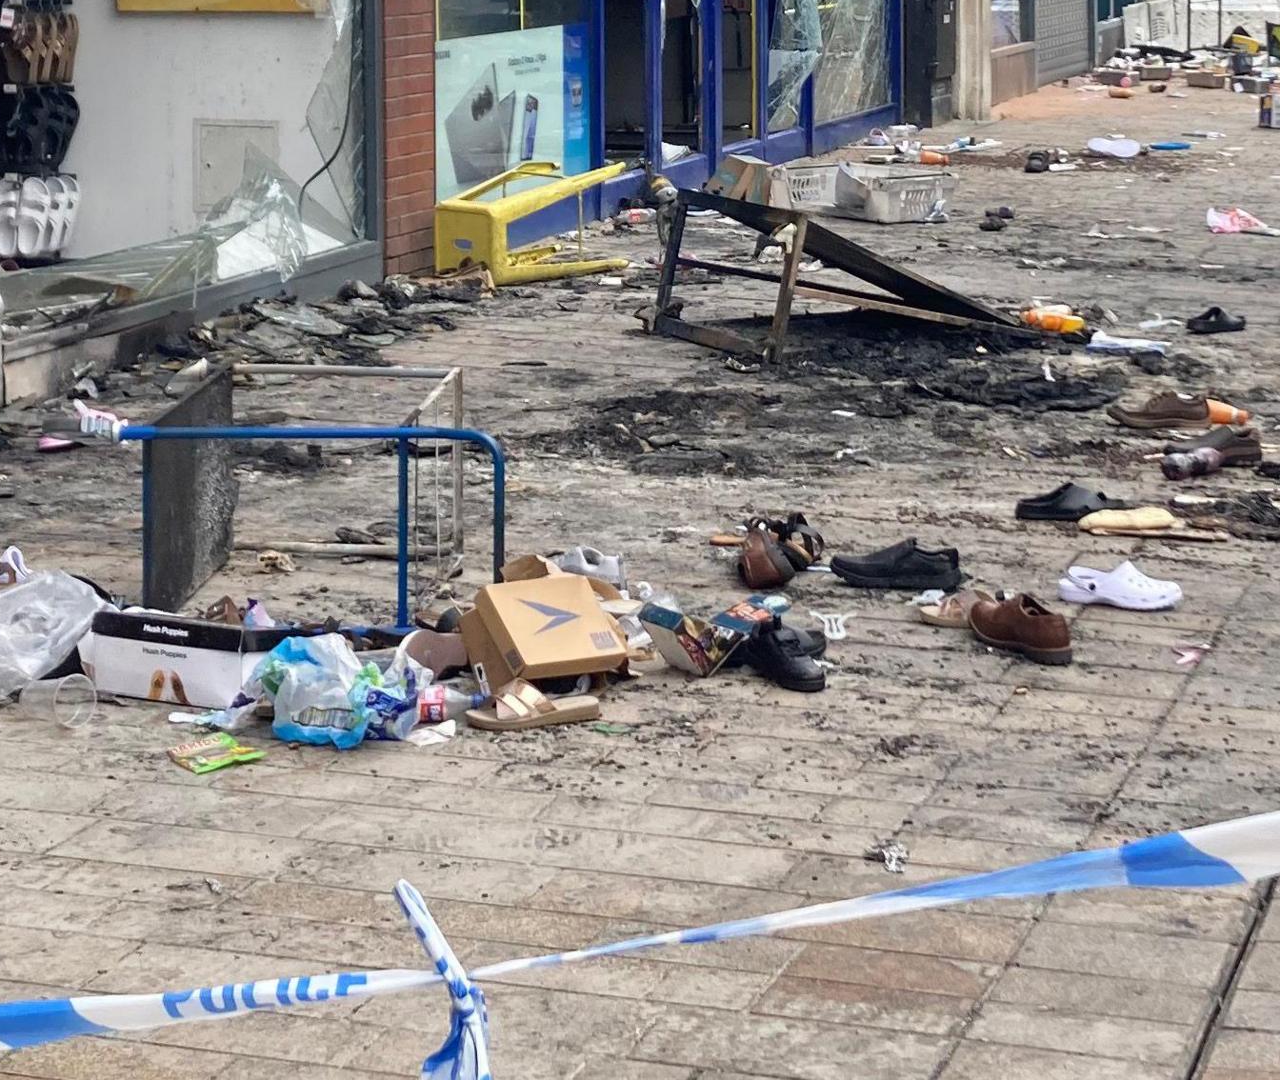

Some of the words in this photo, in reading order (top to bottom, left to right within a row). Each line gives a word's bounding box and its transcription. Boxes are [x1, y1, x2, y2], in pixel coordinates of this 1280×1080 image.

[143, 623, 162, 635] Hush
[162, 625, 189, 638] Puppies
[142, 646, 160, 656] Hush
[160, 648, 188, 660] Puppies
